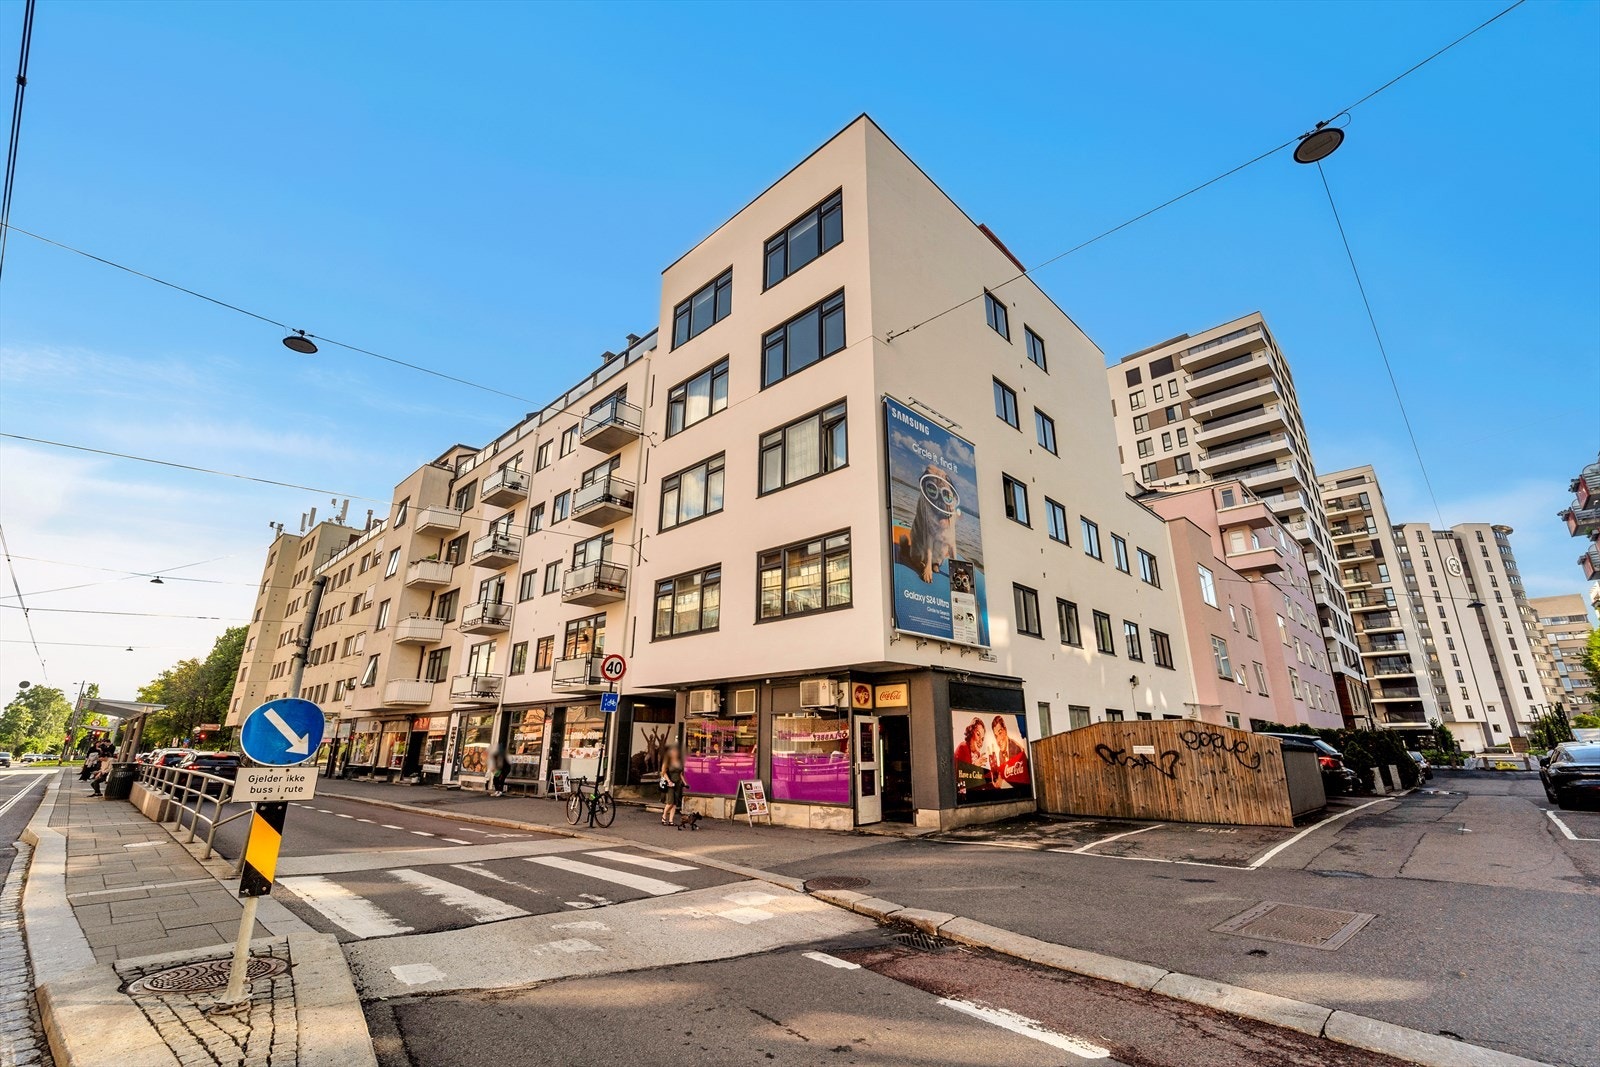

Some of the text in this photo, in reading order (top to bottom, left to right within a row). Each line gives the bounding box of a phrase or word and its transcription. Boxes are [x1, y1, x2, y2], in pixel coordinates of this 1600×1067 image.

[891, 407, 930, 436] SAMSUNG
[912, 443, 932, 460] Circle
[940, 456, 953, 471] find
[953, 462, 959, 474] it
[903, 589, 950, 609] Galaxy S24 Ultra
[606, 661, 622, 675] 40
[248, 774, 305, 784] Gjelder ikke
[958, 769, 969, 779] Have
[972, 770, 983, 780] Coke
[250, 785, 304, 794] buss i rute
